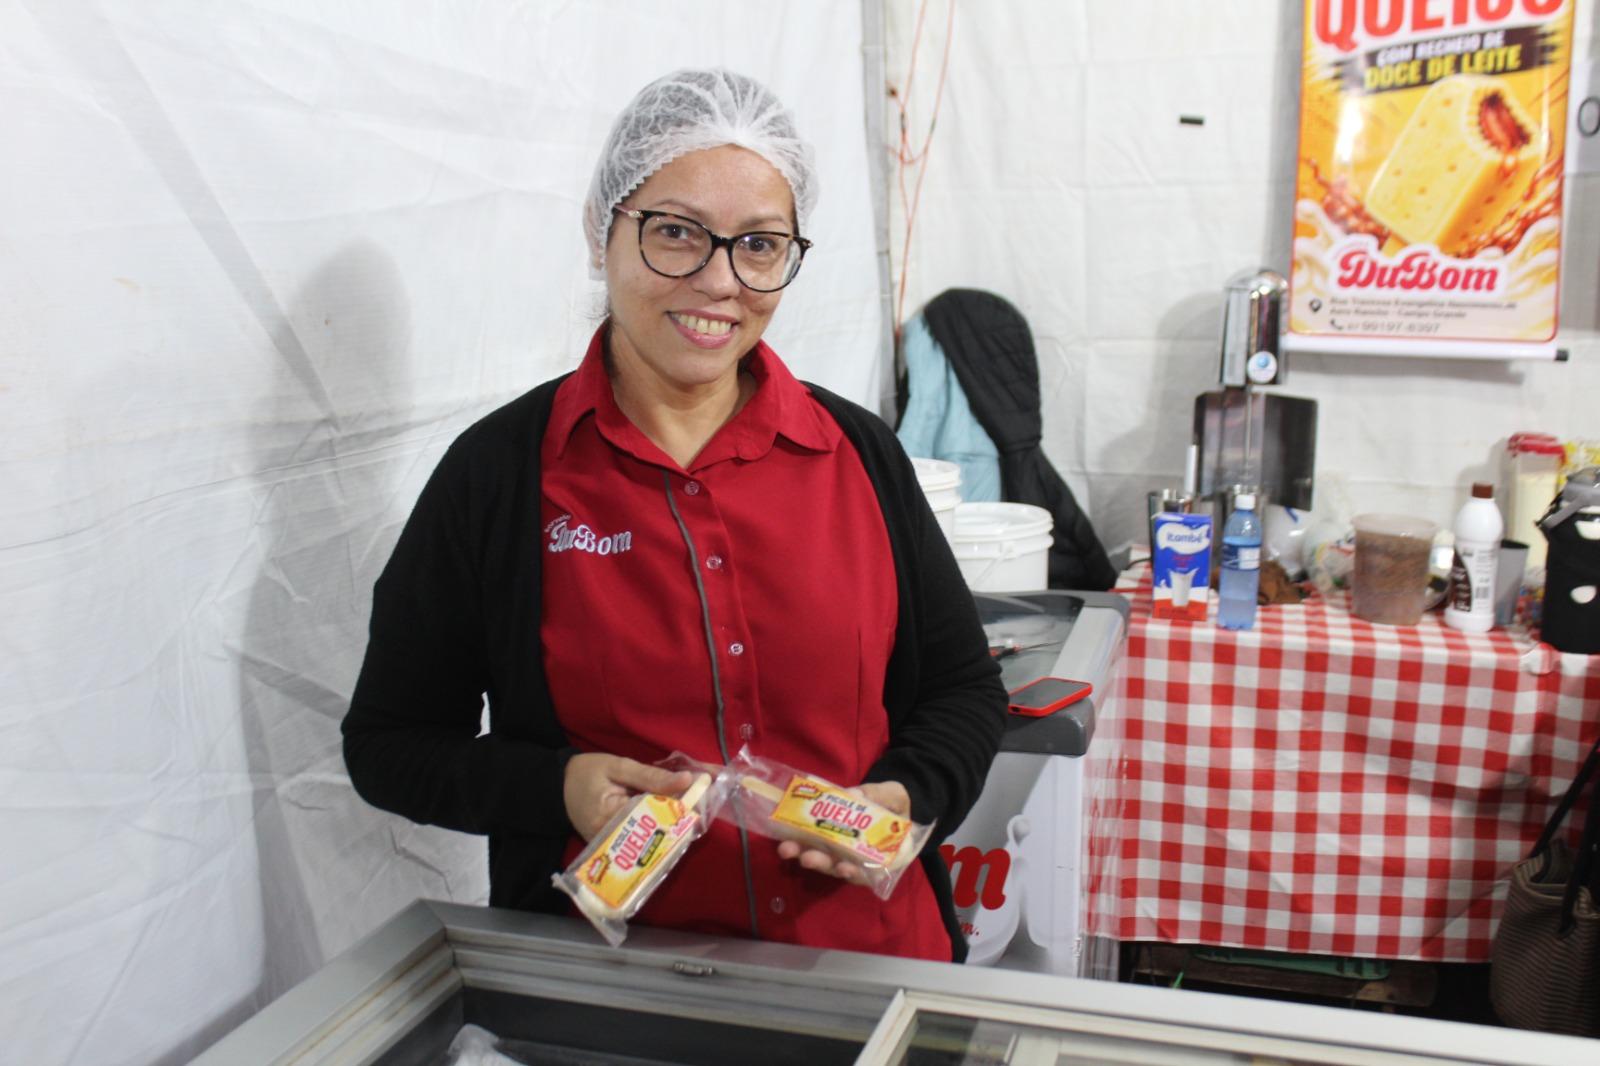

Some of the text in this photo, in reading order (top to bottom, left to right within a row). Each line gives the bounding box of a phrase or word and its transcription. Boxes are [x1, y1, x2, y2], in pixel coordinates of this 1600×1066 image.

[1315, 0, 1562, 52] QUE
[1365, 44, 1522, 88] DOCE DE LEITE
[1338, 250, 1498, 291] DuBom
[810, 800, 873, 830] QUEIJO
[614, 814, 658, 871] QUEIJO
